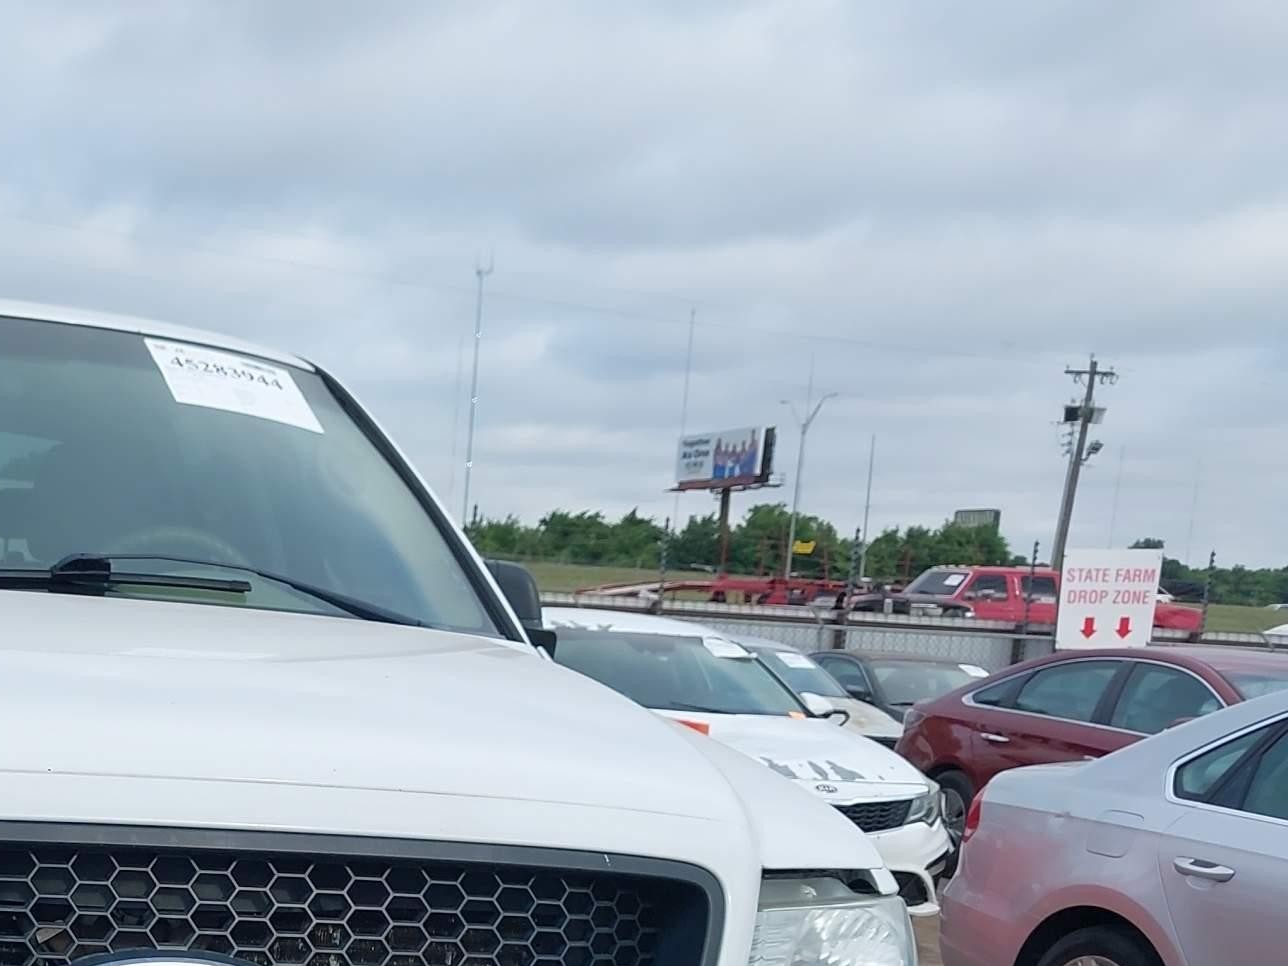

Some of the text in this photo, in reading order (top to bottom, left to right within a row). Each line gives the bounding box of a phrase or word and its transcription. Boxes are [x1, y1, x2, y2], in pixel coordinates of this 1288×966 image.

[170, 355, 284, 391] 45283944
[1066, 567, 1157, 583] STATE FARM
[1067, 589, 1151, 605] DROP ZONE
